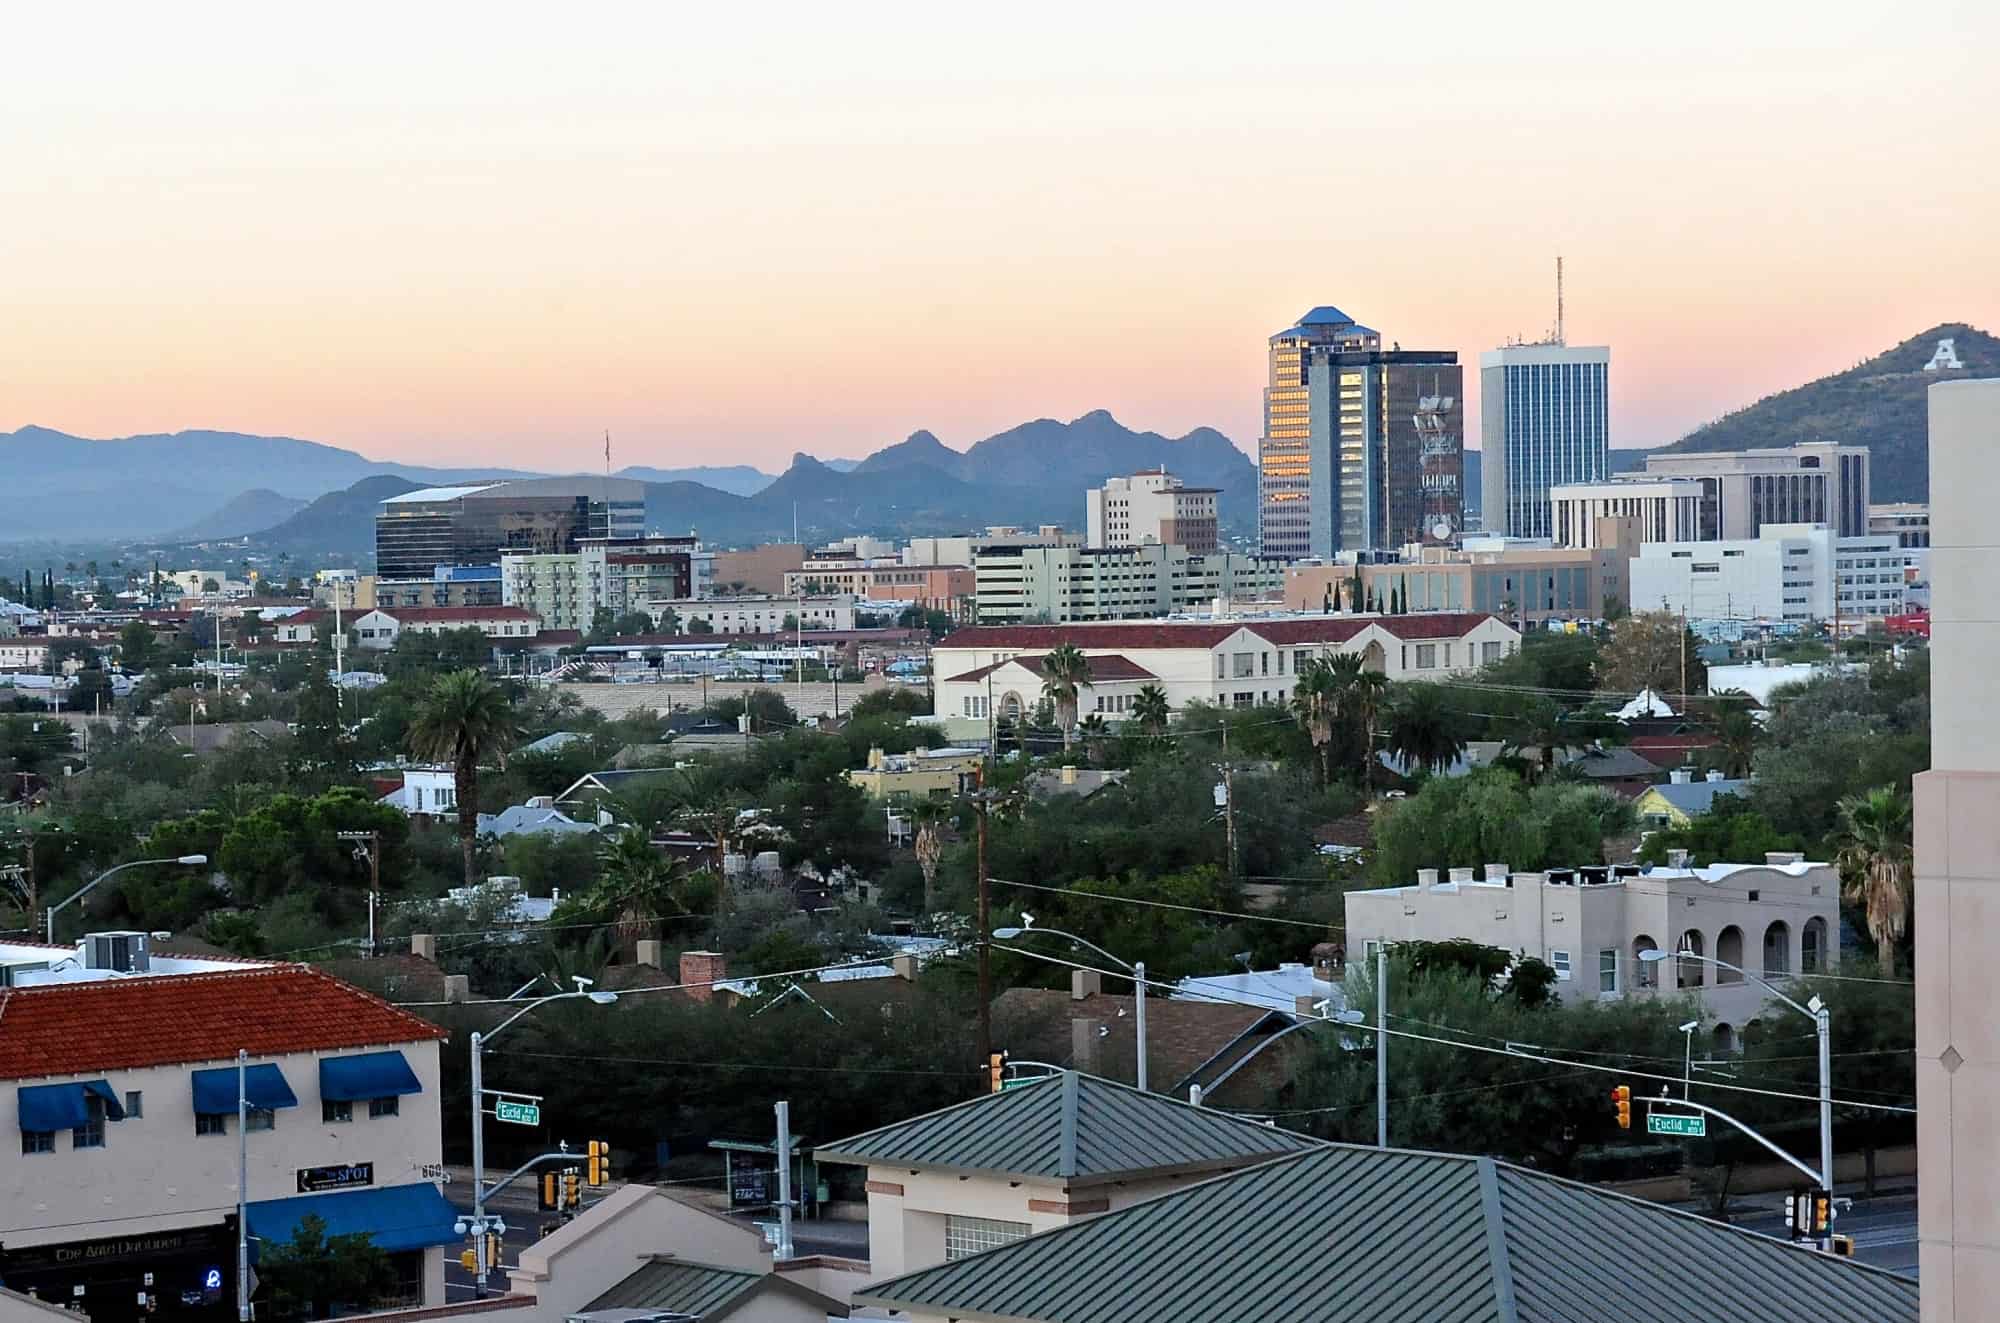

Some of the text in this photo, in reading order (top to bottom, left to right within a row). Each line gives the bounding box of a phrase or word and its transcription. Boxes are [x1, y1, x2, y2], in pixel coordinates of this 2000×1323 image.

[1923, 338, 1963, 370] A
[501, 1105, 521, 1119] Euclid
[1655, 1118, 1682, 1131] Euclid
[337, 1167, 369, 1181] SPOT
